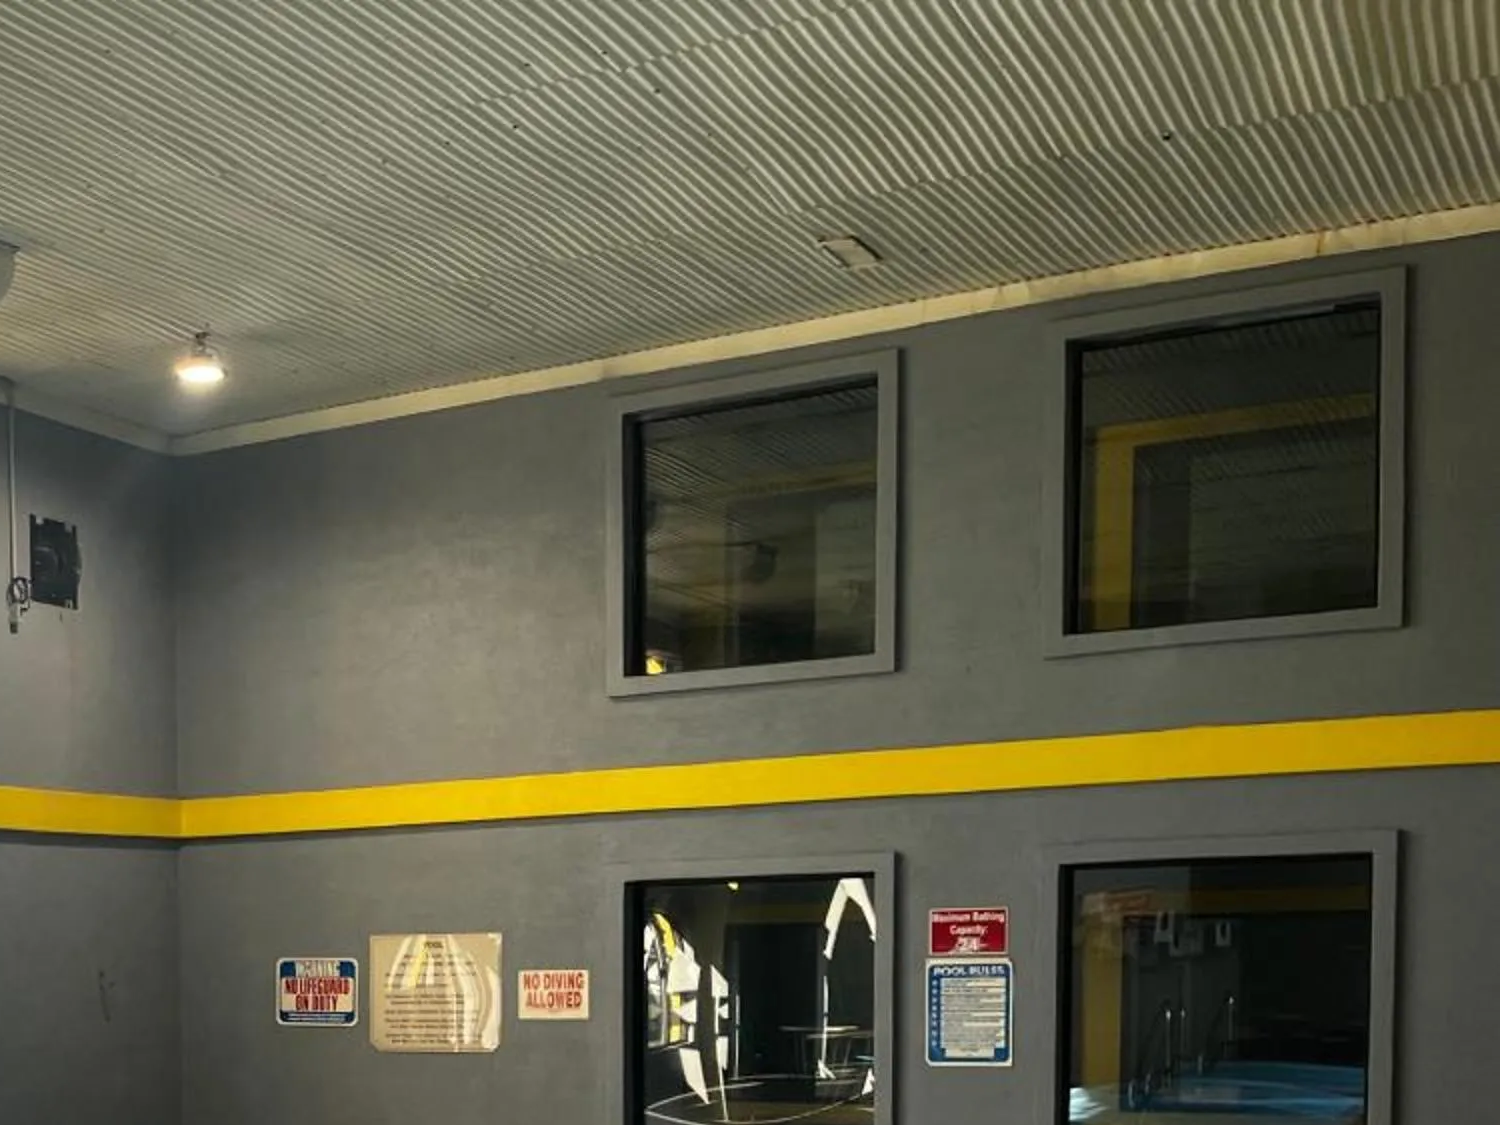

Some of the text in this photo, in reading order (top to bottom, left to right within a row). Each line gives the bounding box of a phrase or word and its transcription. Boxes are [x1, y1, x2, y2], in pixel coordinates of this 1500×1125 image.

[933, 965, 1005, 976] POOL RULES
[285, 977, 350, 994] NO LIFEGUARD
[523, 971, 584, 991] NO DIVING
[296, 995, 337, 1010] ON DUTY
[526, 991, 582, 1009] ALLOWED
